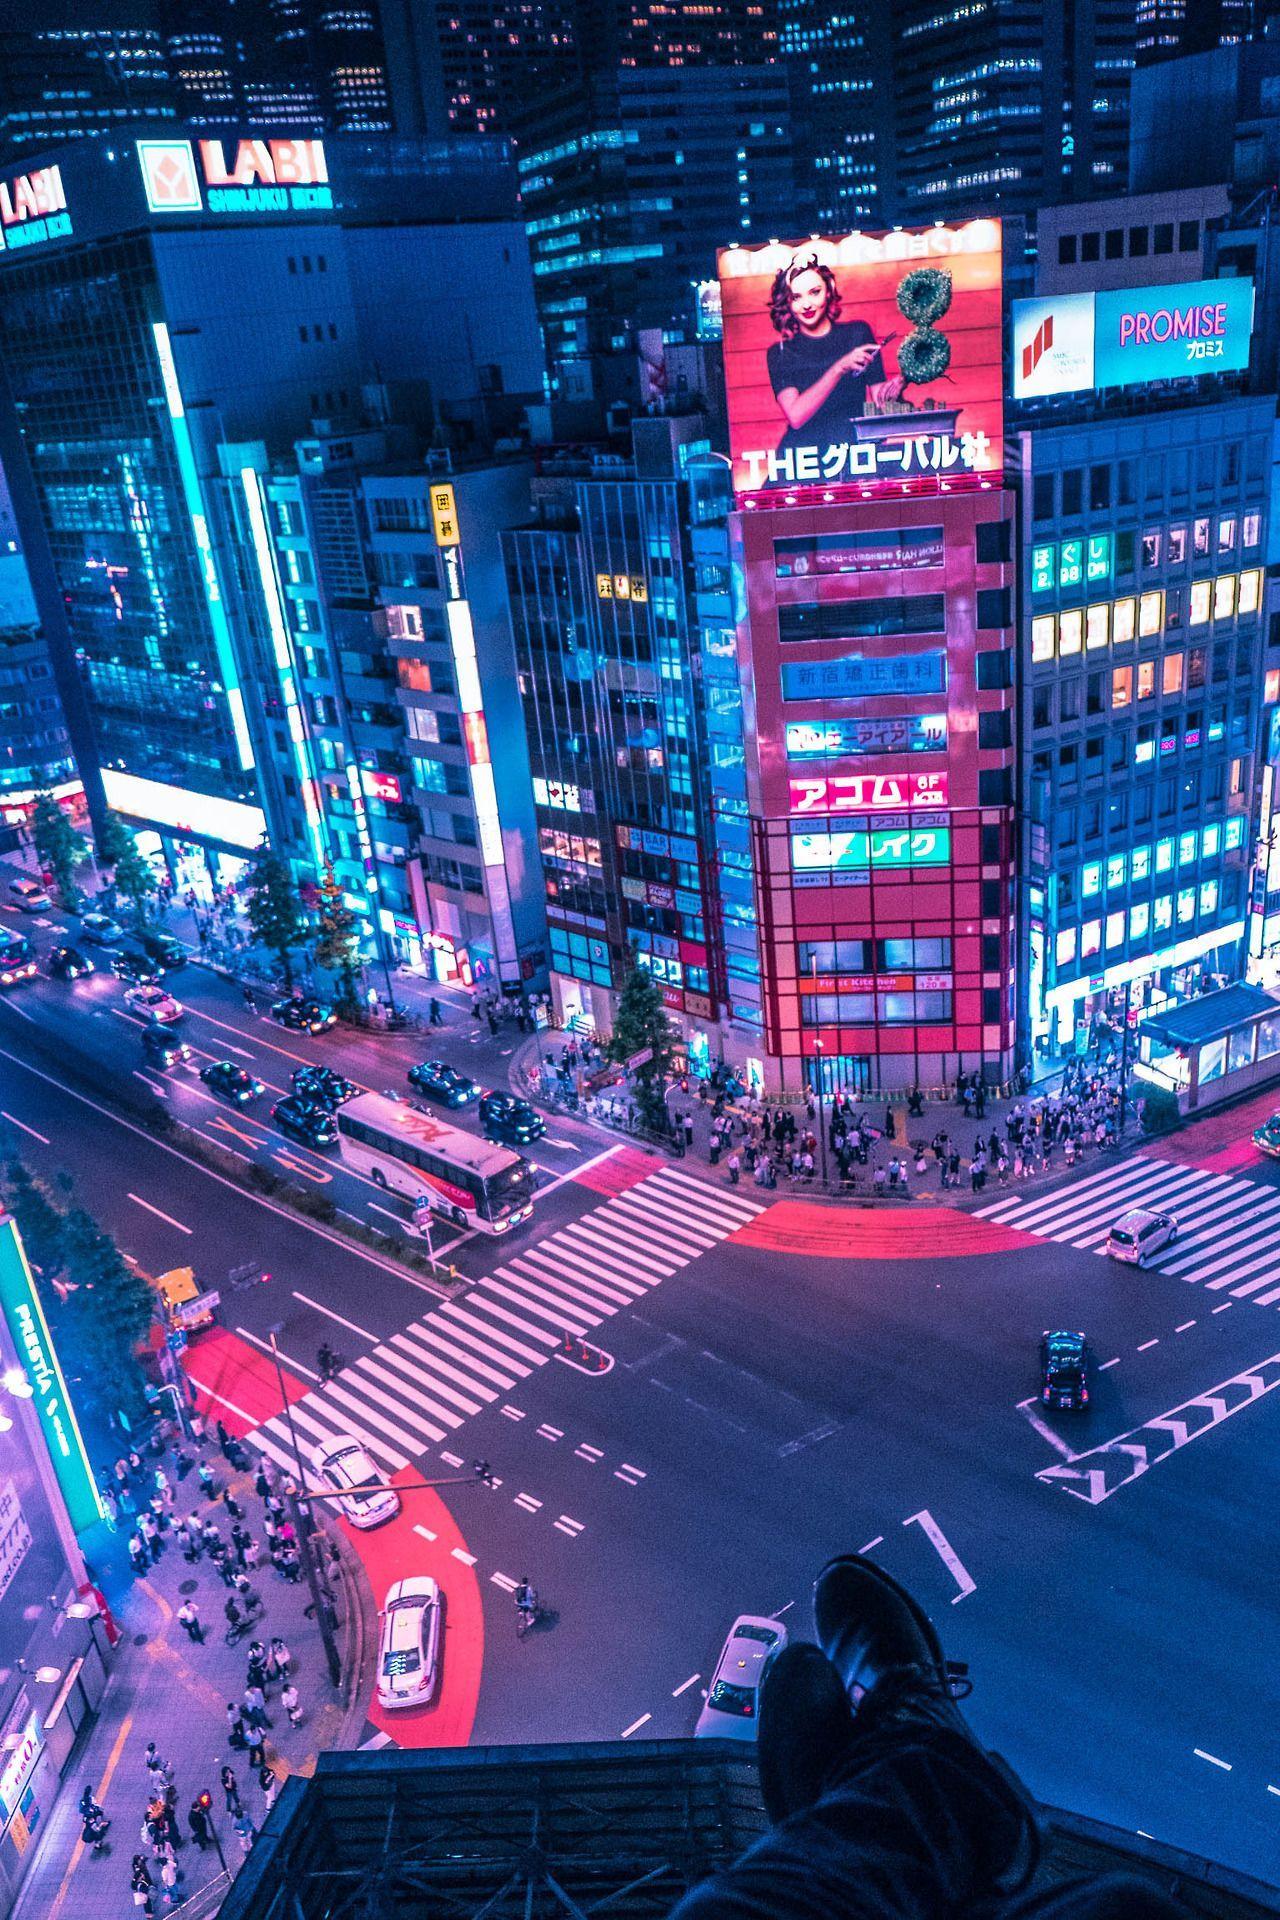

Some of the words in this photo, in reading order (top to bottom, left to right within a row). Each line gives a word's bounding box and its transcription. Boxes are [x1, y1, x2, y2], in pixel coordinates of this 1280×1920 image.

[198, 139, 330, 185] LABI
[0, 164, 67, 226] LABI
[207, 187, 289, 213] SHINJUKU
[1119, 302, 1227, 347] PROMISE
[1186, 339, 1224, 361] プロミス
[741, 431, 992, 483] THEグローバル社
[1034, 540, 1103, 570] ほぐし
[796, 775, 903, 810] アコム
[875, 815, 906, 828] アコム
[915, 814, 947, 827] アコム
[865, 832, 937, 859] レイク
[819, 976, 850, 987] First
[851, 975, 897, 987] Kitchen
